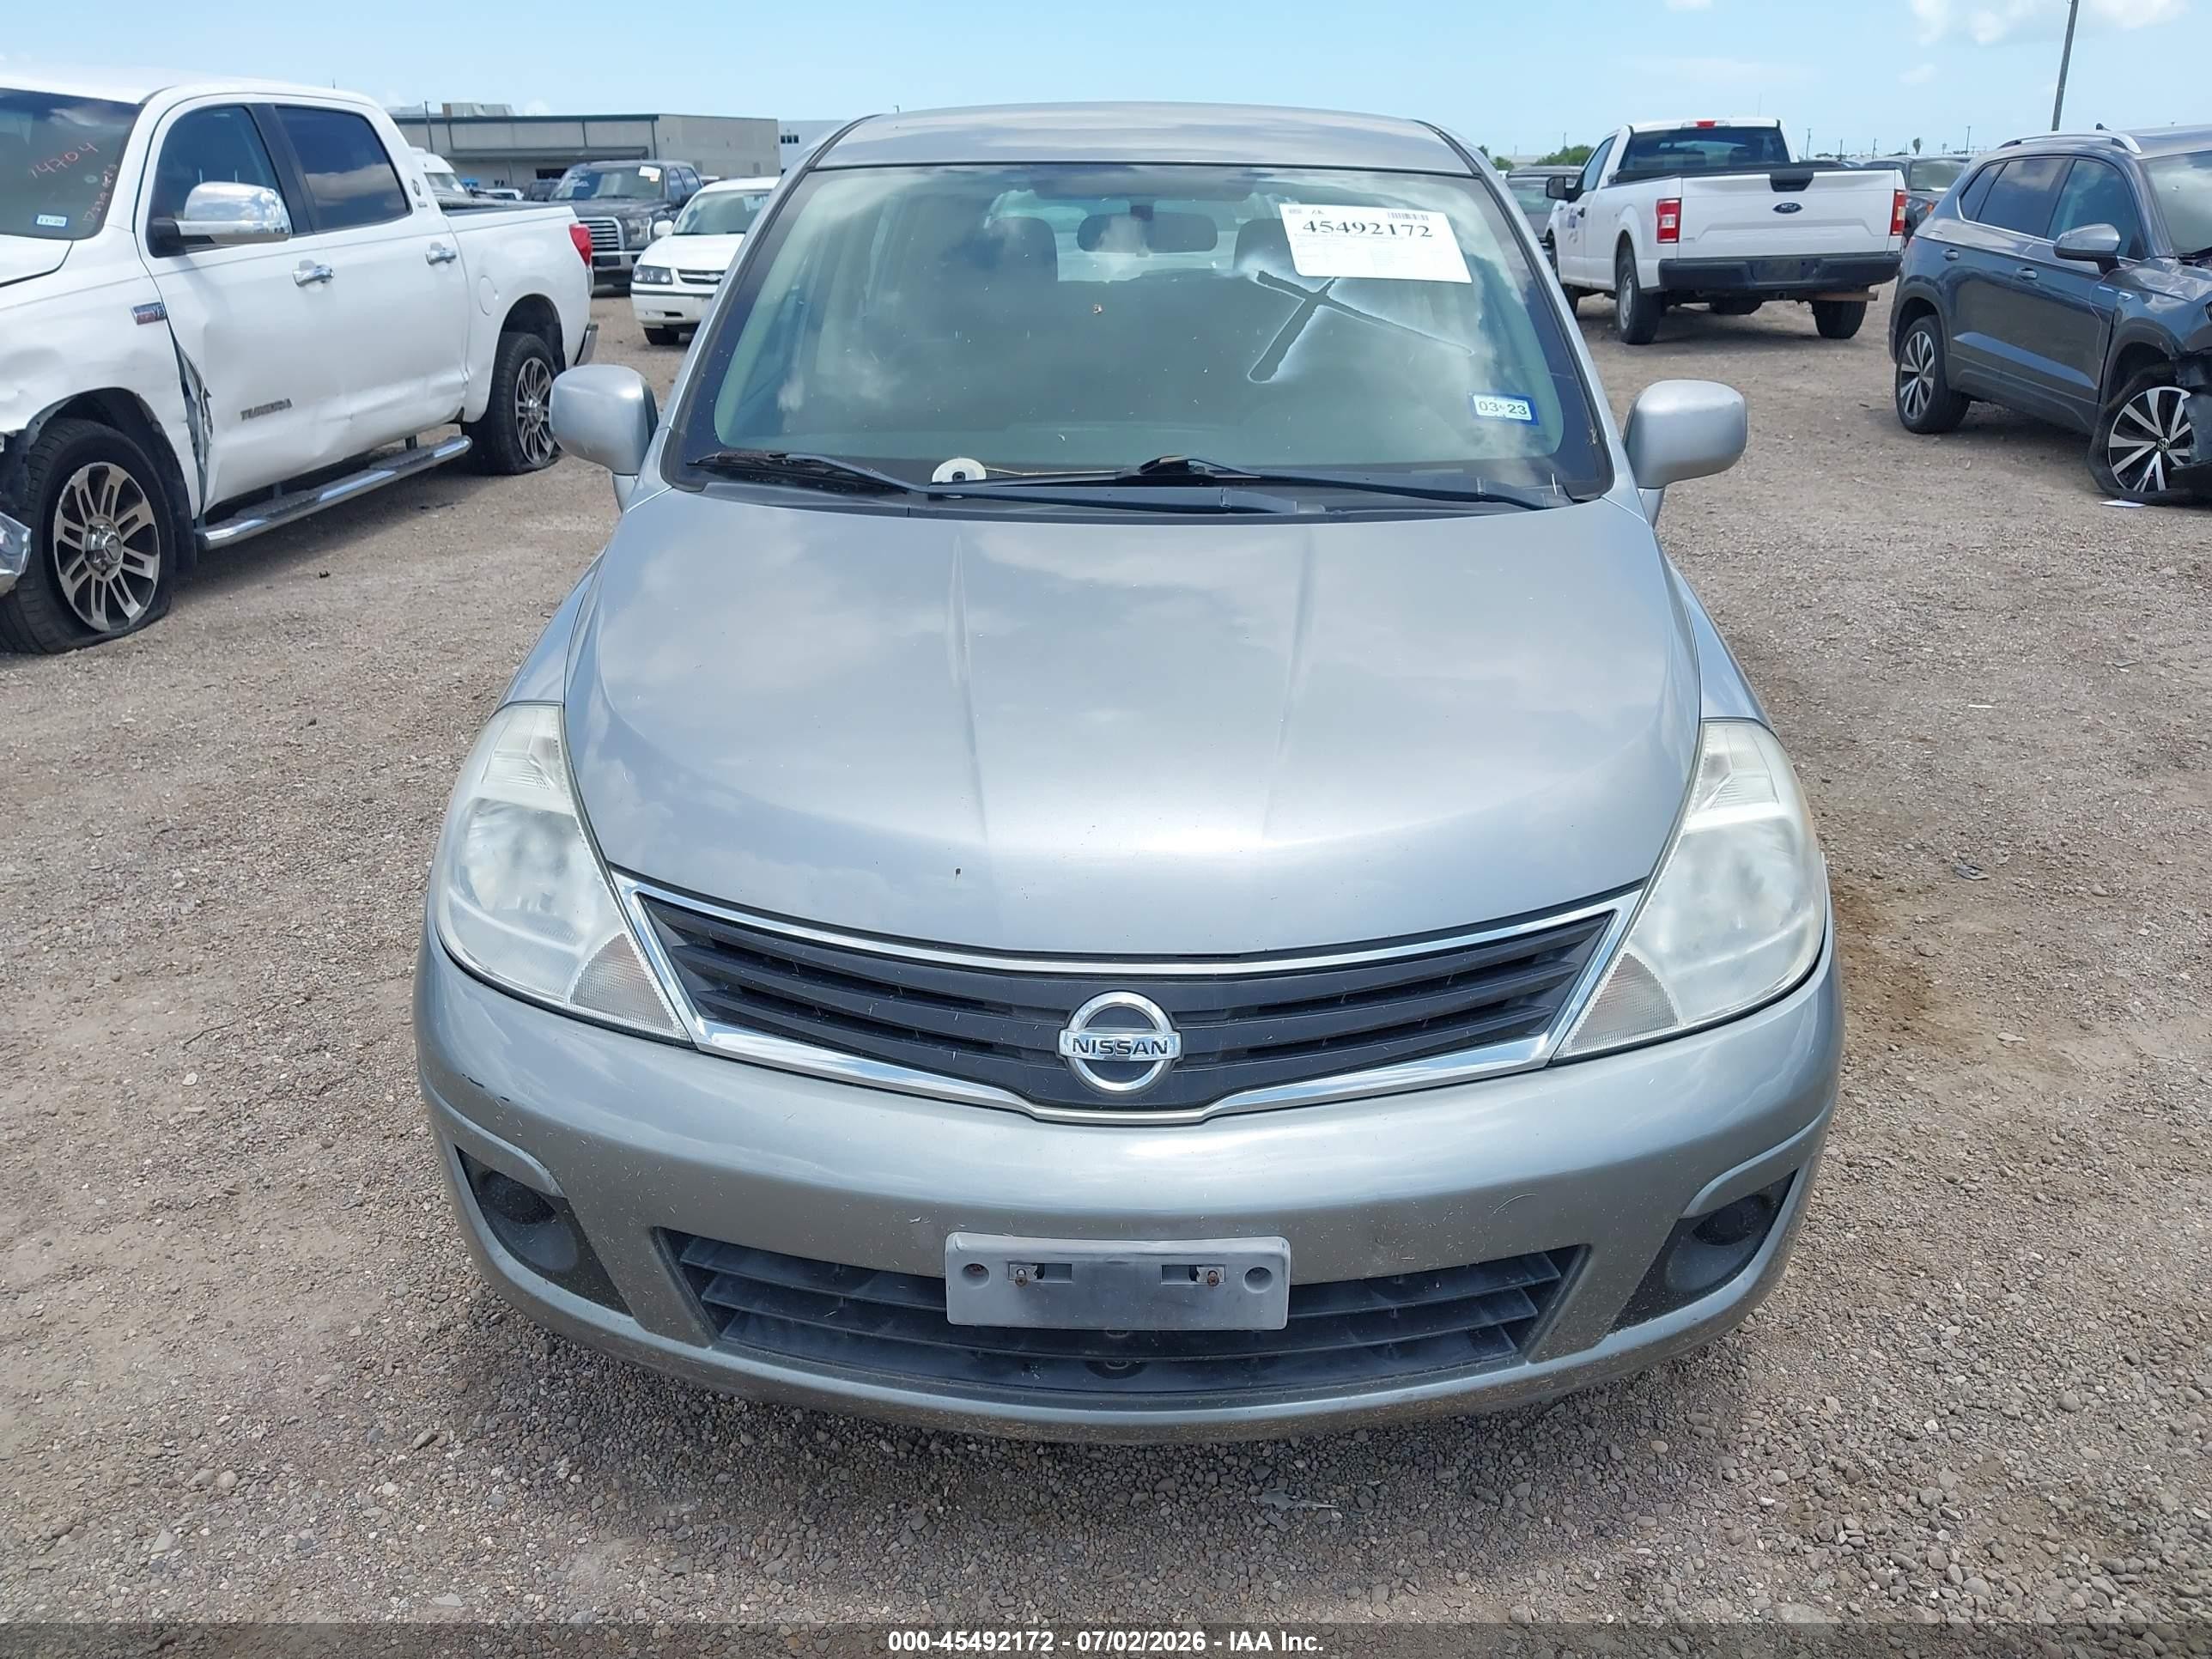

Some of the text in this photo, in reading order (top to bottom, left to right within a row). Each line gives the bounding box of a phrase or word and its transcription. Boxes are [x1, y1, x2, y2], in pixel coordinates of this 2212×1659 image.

[32, 143, 99, 179] 14704
[1302, 220, 1433, 238] 45492172
[1507, 404, 1528, 416] 23
[1072, 1037, 1169, 1056] NISSAN
